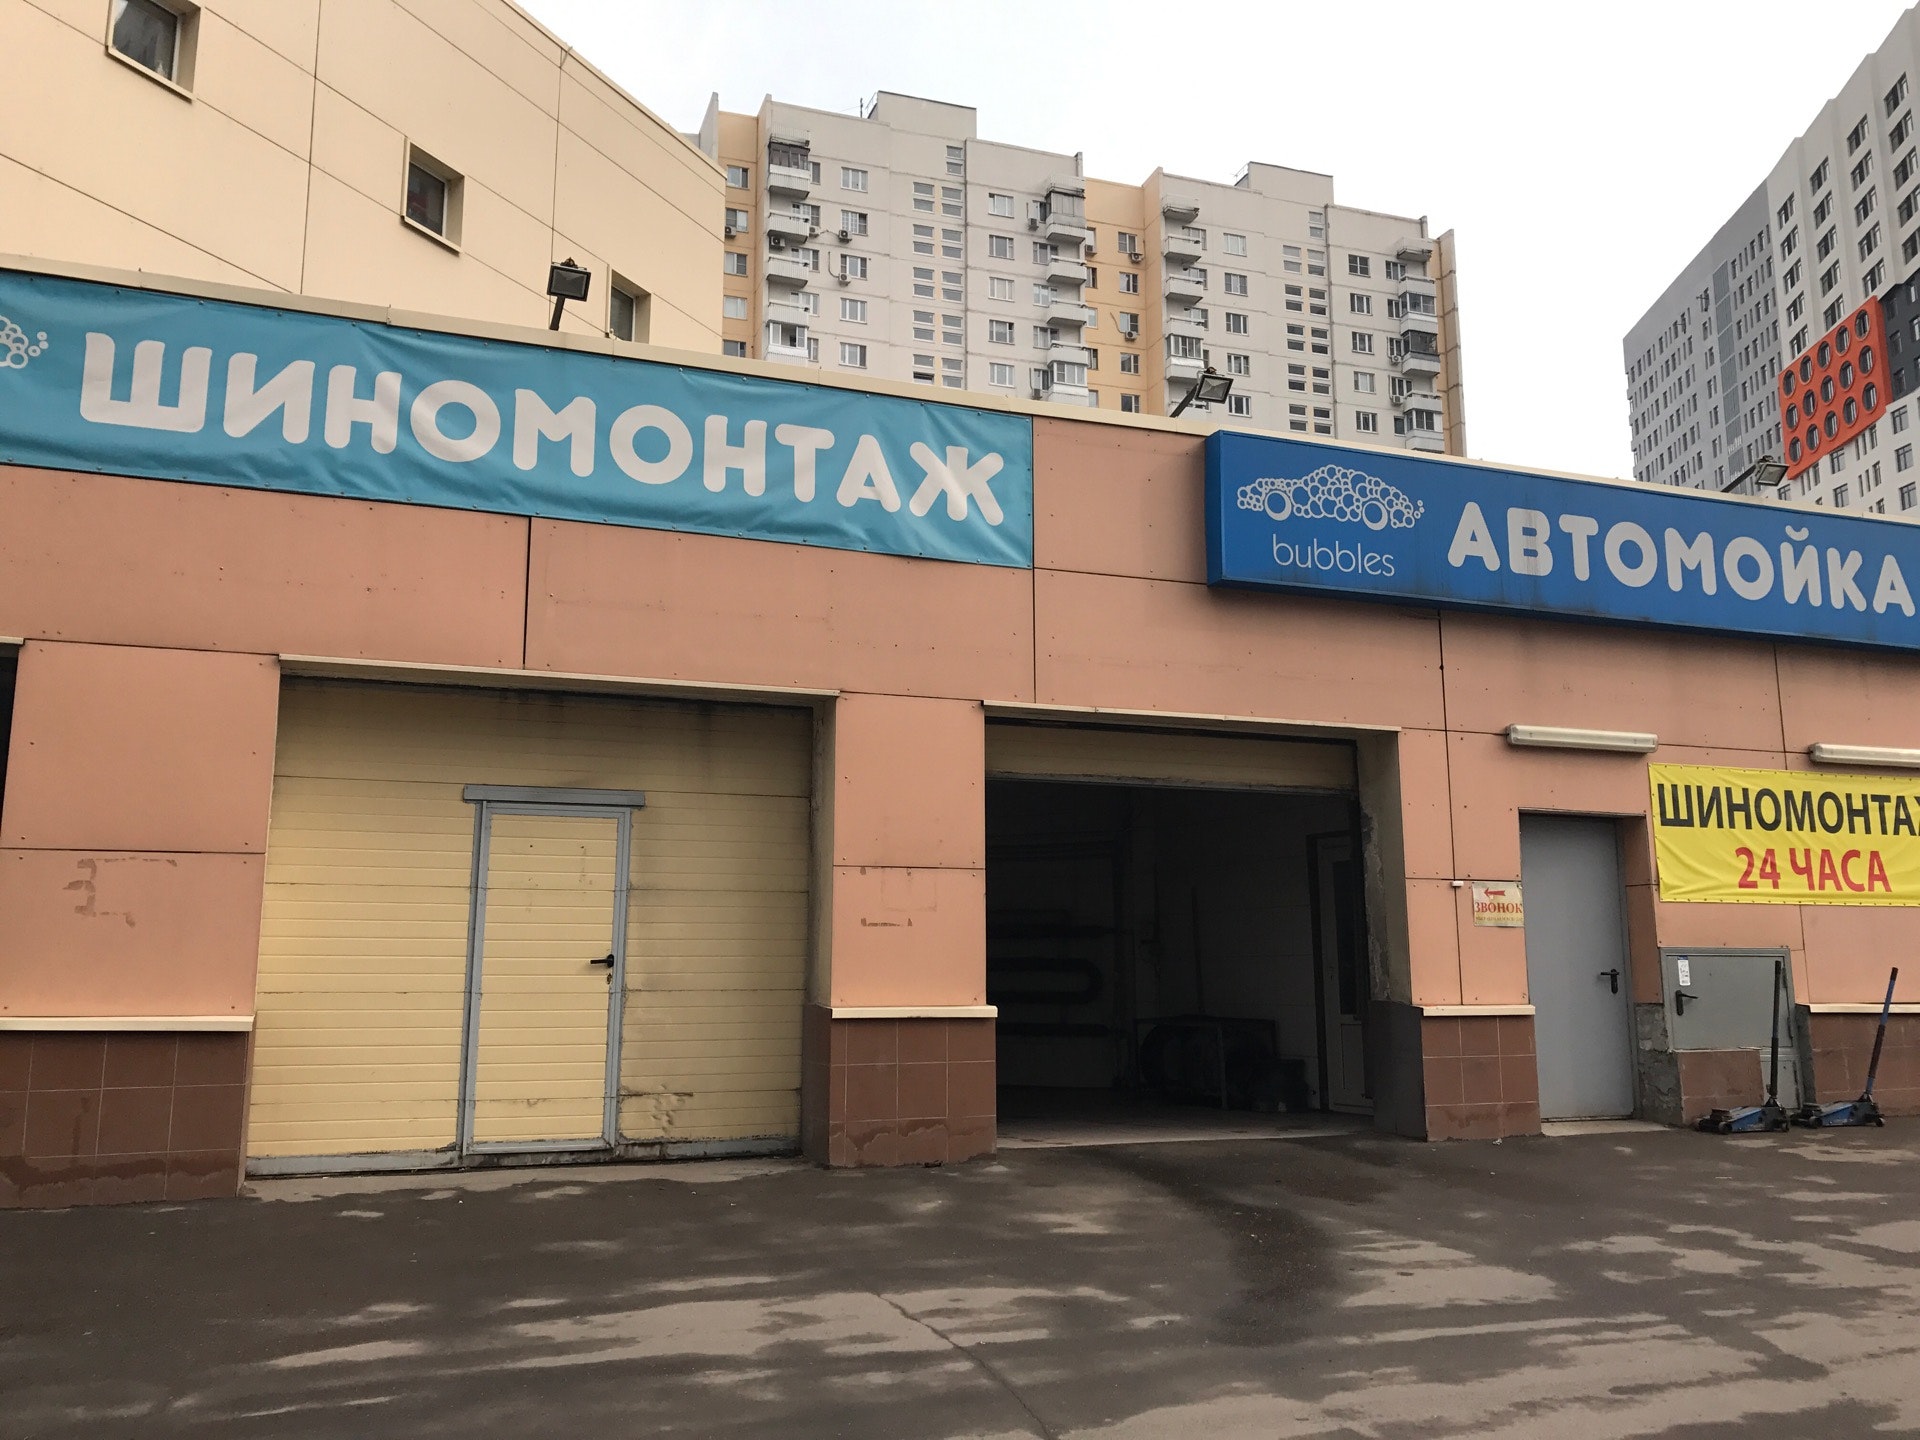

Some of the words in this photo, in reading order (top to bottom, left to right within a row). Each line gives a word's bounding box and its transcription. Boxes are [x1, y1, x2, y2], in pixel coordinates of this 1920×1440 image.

[80, 332, 1005, 526] ШИНОМОНТАЖ
[1272, 533, 1396, 578] bubbles
[1447, 501, 1916, 617] АВТОМОЙКА
[1657, 784, 1920, 837] ШИНОМОНТА
[1735, 846, 1780, 890] 24
[1789, 848, 1893, 893] ЧАСА
[1475, 902, 1523, 914] ЗВОНОК
